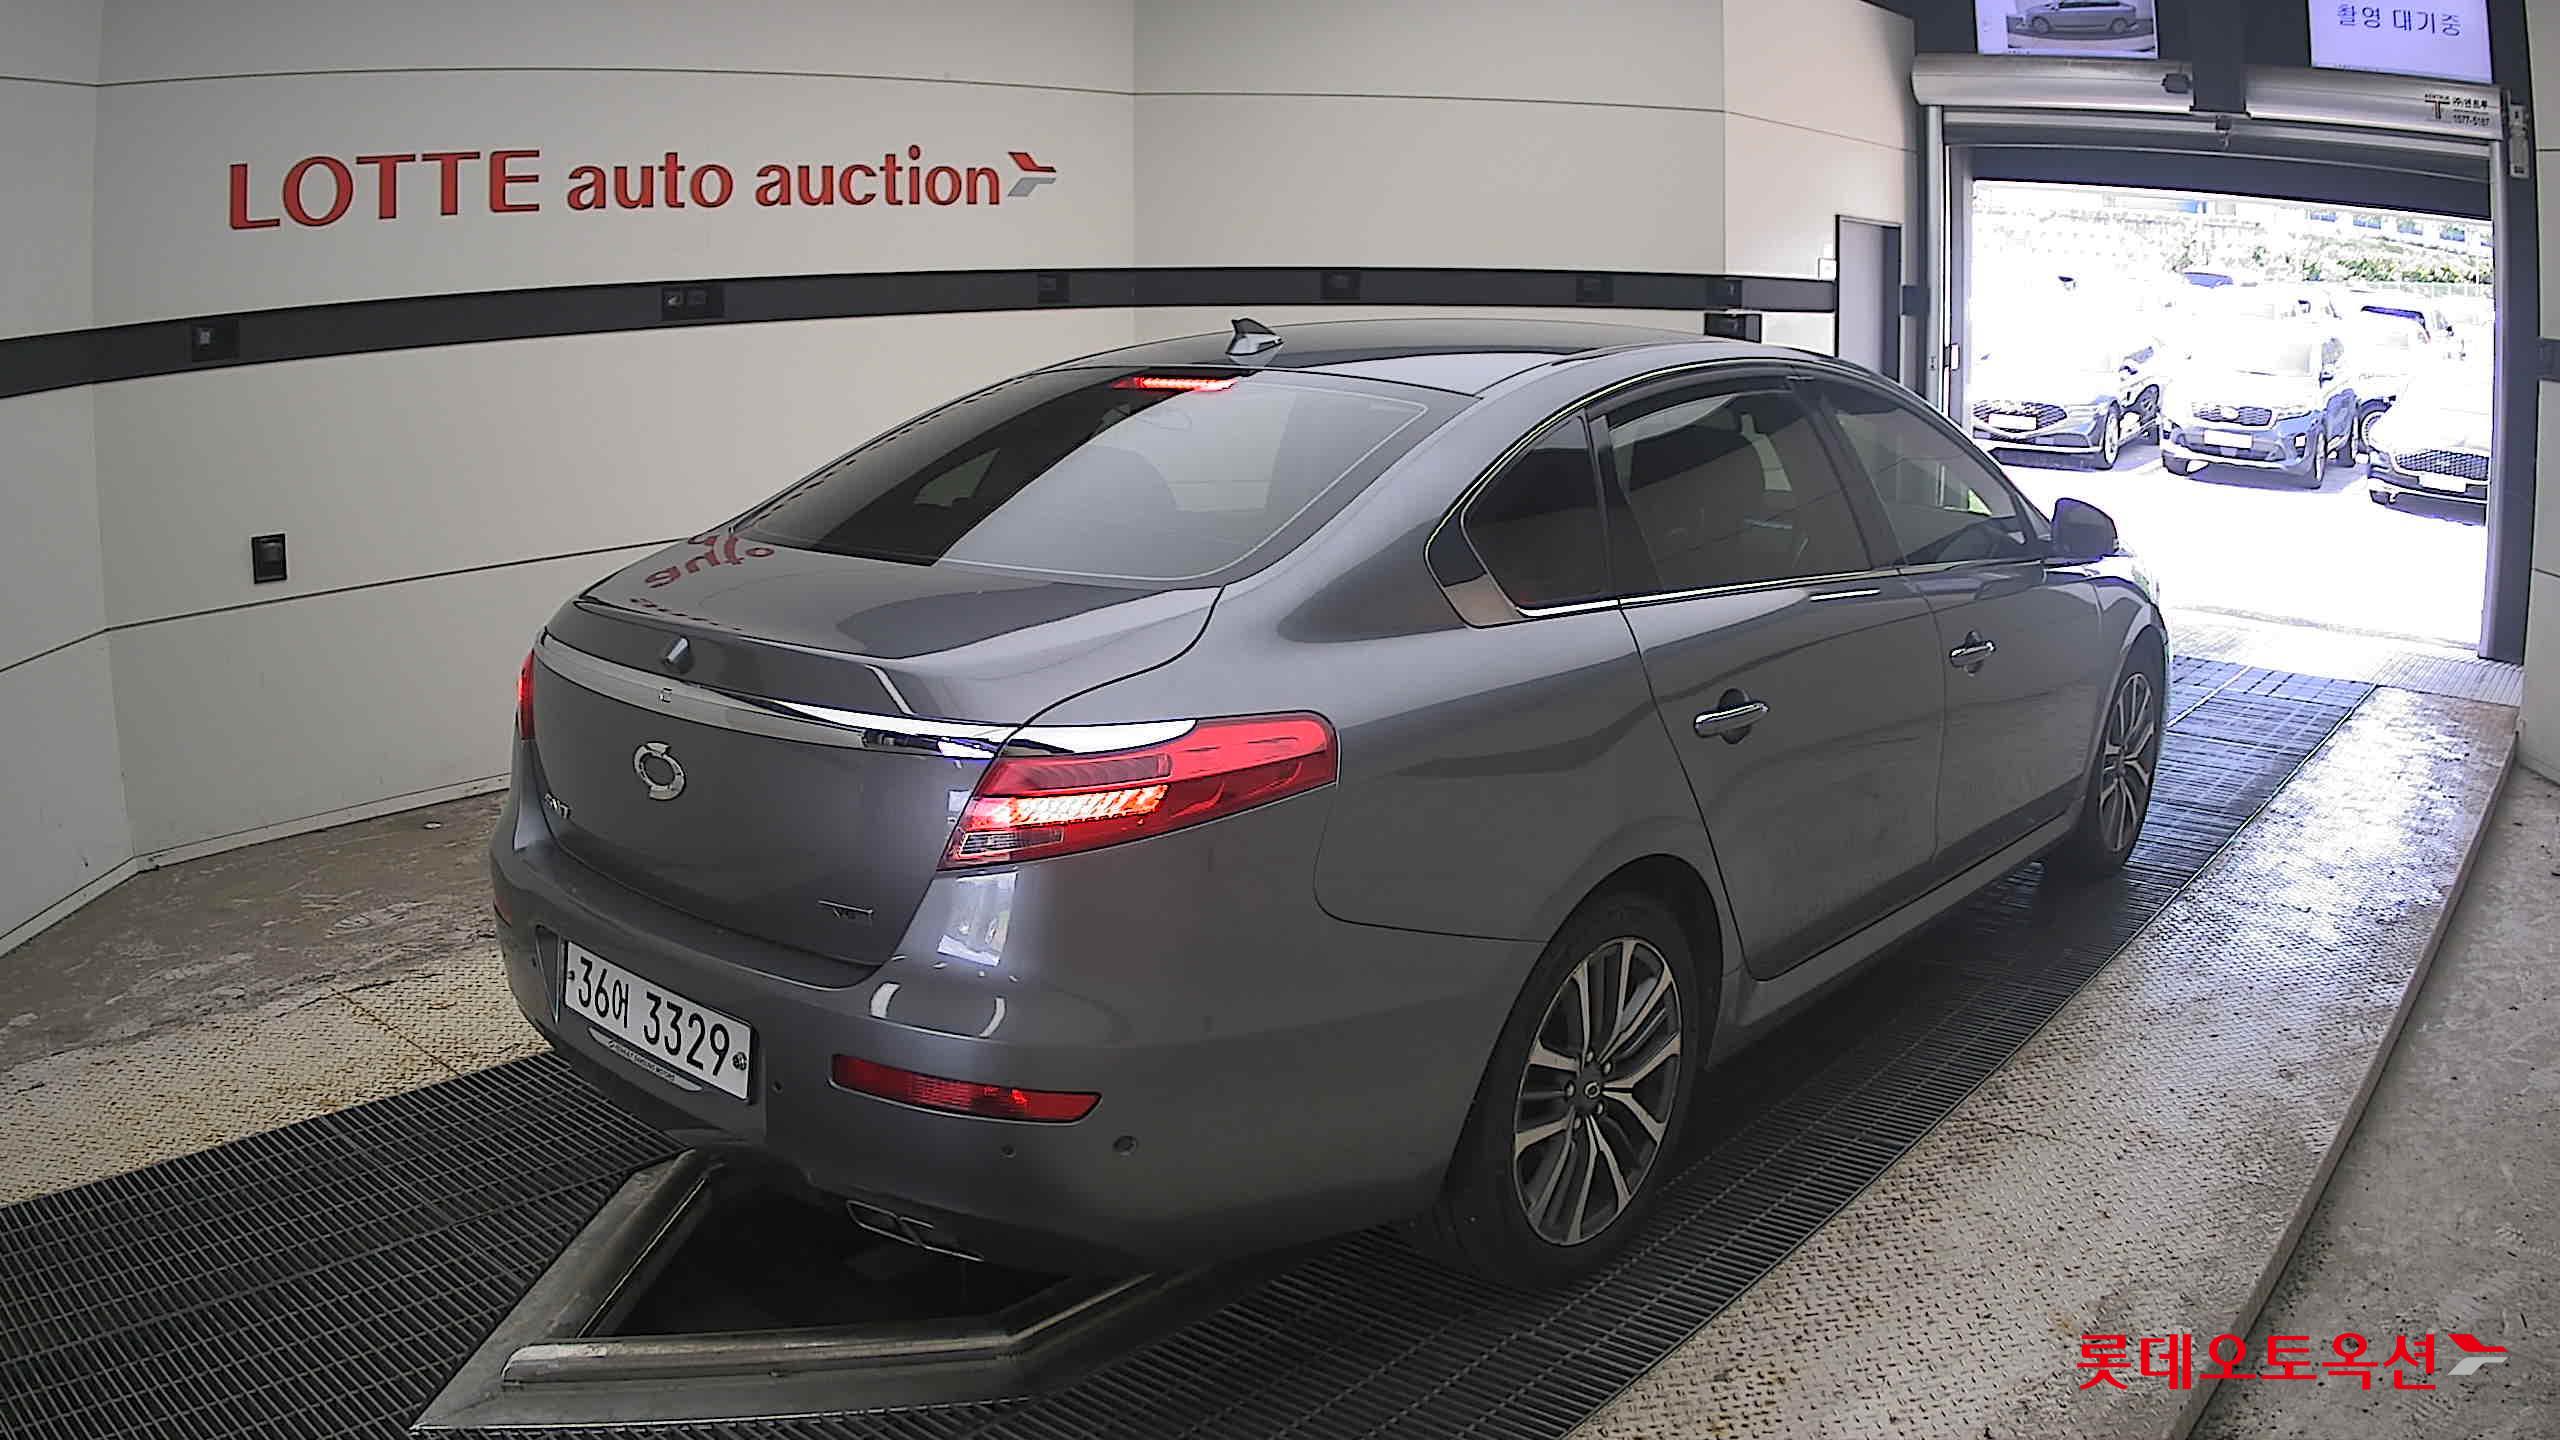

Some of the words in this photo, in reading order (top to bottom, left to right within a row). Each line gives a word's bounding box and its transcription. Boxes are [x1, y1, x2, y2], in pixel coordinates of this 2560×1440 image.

[2337, 4, 2382, 30] 촬영
[2392, 9, 2461, 37] 대기중
[229, 150, 541, 230] LOTTE
[567, 152, 735, 210] auto
[755, 146, 1003, 207] auction
[578, 956, 630, 1029] 36어
[643, 991, 731, 1077] 3329
